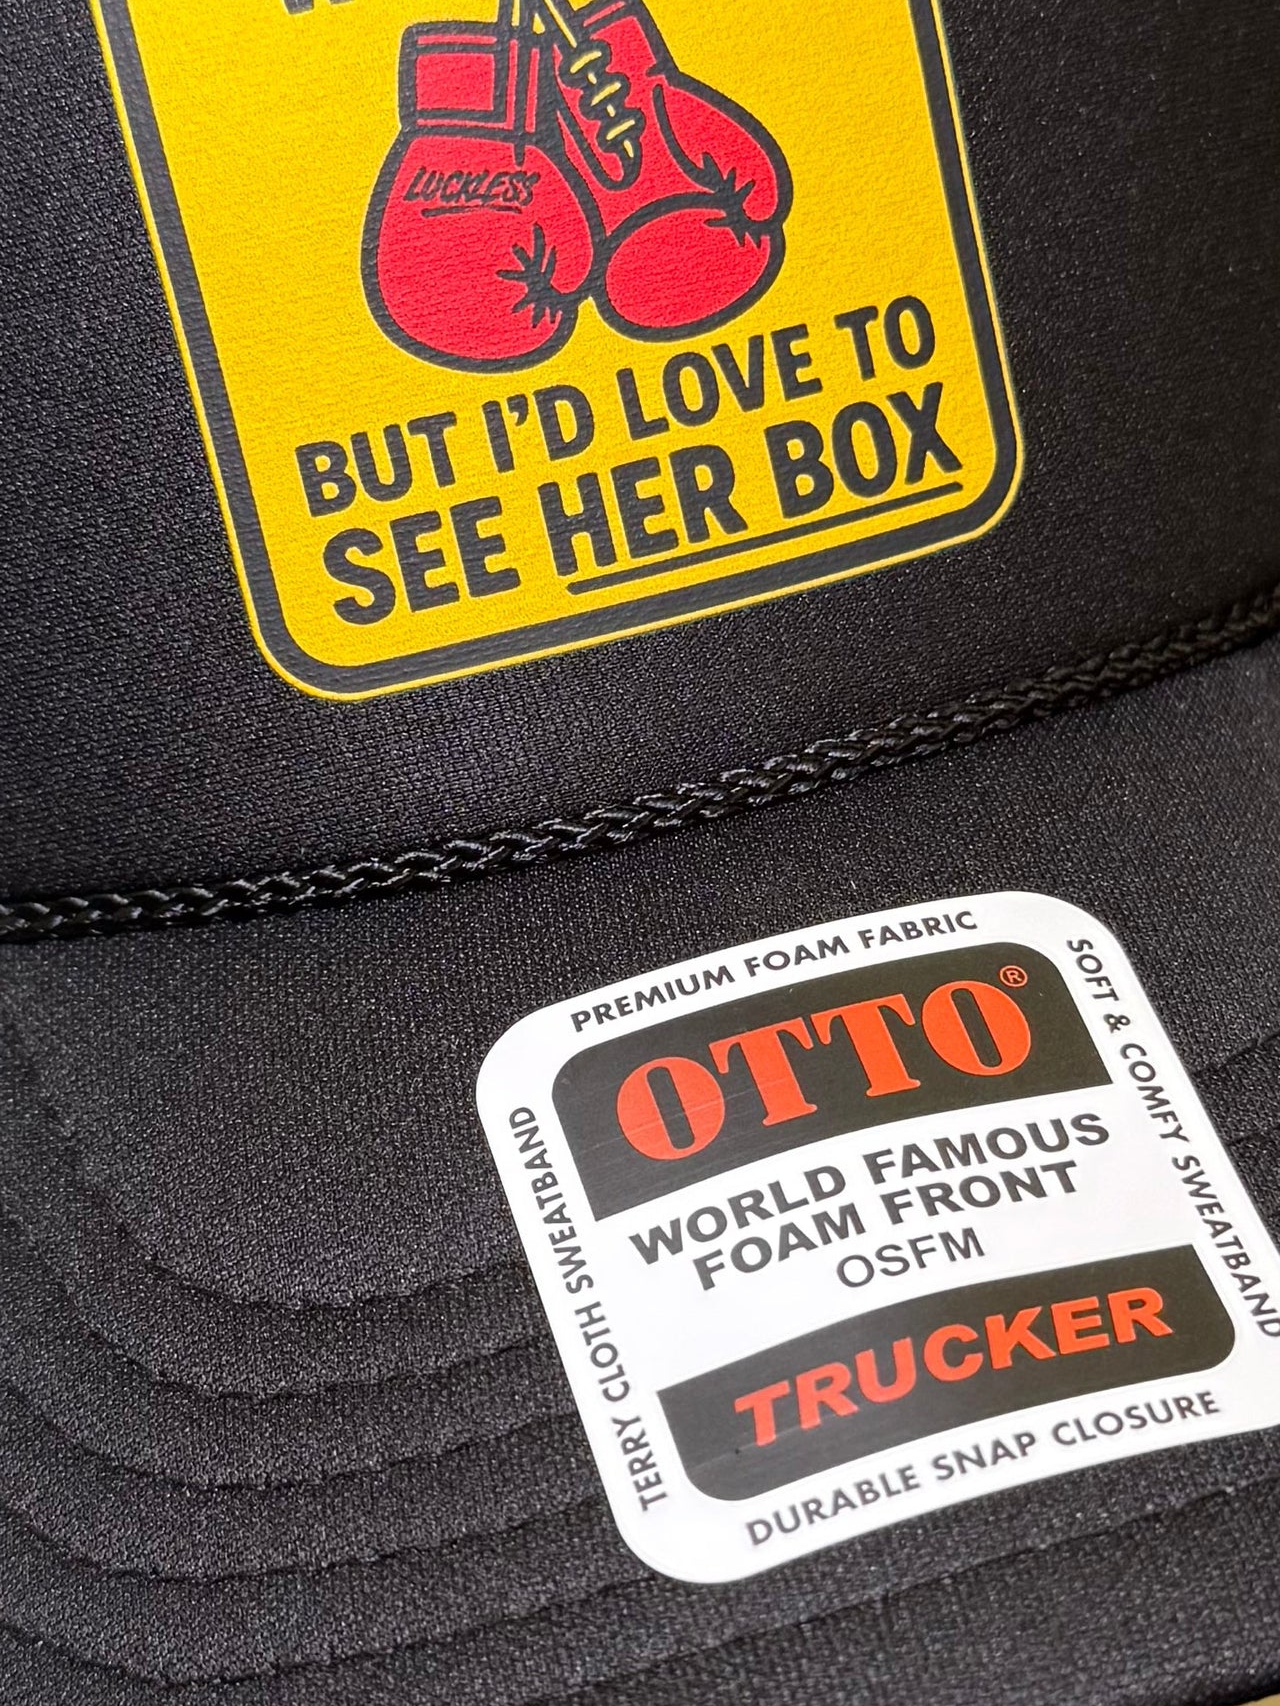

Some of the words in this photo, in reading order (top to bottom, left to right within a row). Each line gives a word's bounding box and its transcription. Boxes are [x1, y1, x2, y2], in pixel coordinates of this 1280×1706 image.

[403, 166, 540, 206] LUCKLESS
[295, 412, 461, 517] BUT
[481, 386, 594, 474] I'D
[616, 324, 819, 434] LOVE
[835, 296, 935, 380] TO
[323, 496, 518, 625] SEE
[538, 442, 747, 577] HER
[766, 380, 962, 519] BOX
[572, 965, 733, 1033] PREMIUM
[745, 935, 851, 978] FOAM
[859, 910, 978, 953] FABRIC
[1068, 938, 1118, 1007] SOFT
[1106, 1014, 1127, 1033] &
[1120, 1042, 1189, 1144] COMFY
[615, 978, 1032, 1161] OTTO
[509, 1105, 594, 1290] SWEATBAND
[629, 1163, 847, 1265] WORLD
[864, 1112, 1110, 1185] FAMOUS
[692, 1205, 867, 1291] FOAM
[884, 1159, 1079, 1226] FRONT
[837, 1227, 986, 1291] OSFM
[574, 1302, 632, 1402] CLOTH
[734, 1286, 1173, 1448] TRUCKER
[613, 1412, 669, 1512] TERRY
[745, 1464, 921, 1546] DURABLE
[933, 1432, 1038, 1482] SNAP
[1051, 1391, 1221, 1445] CLOSURE
